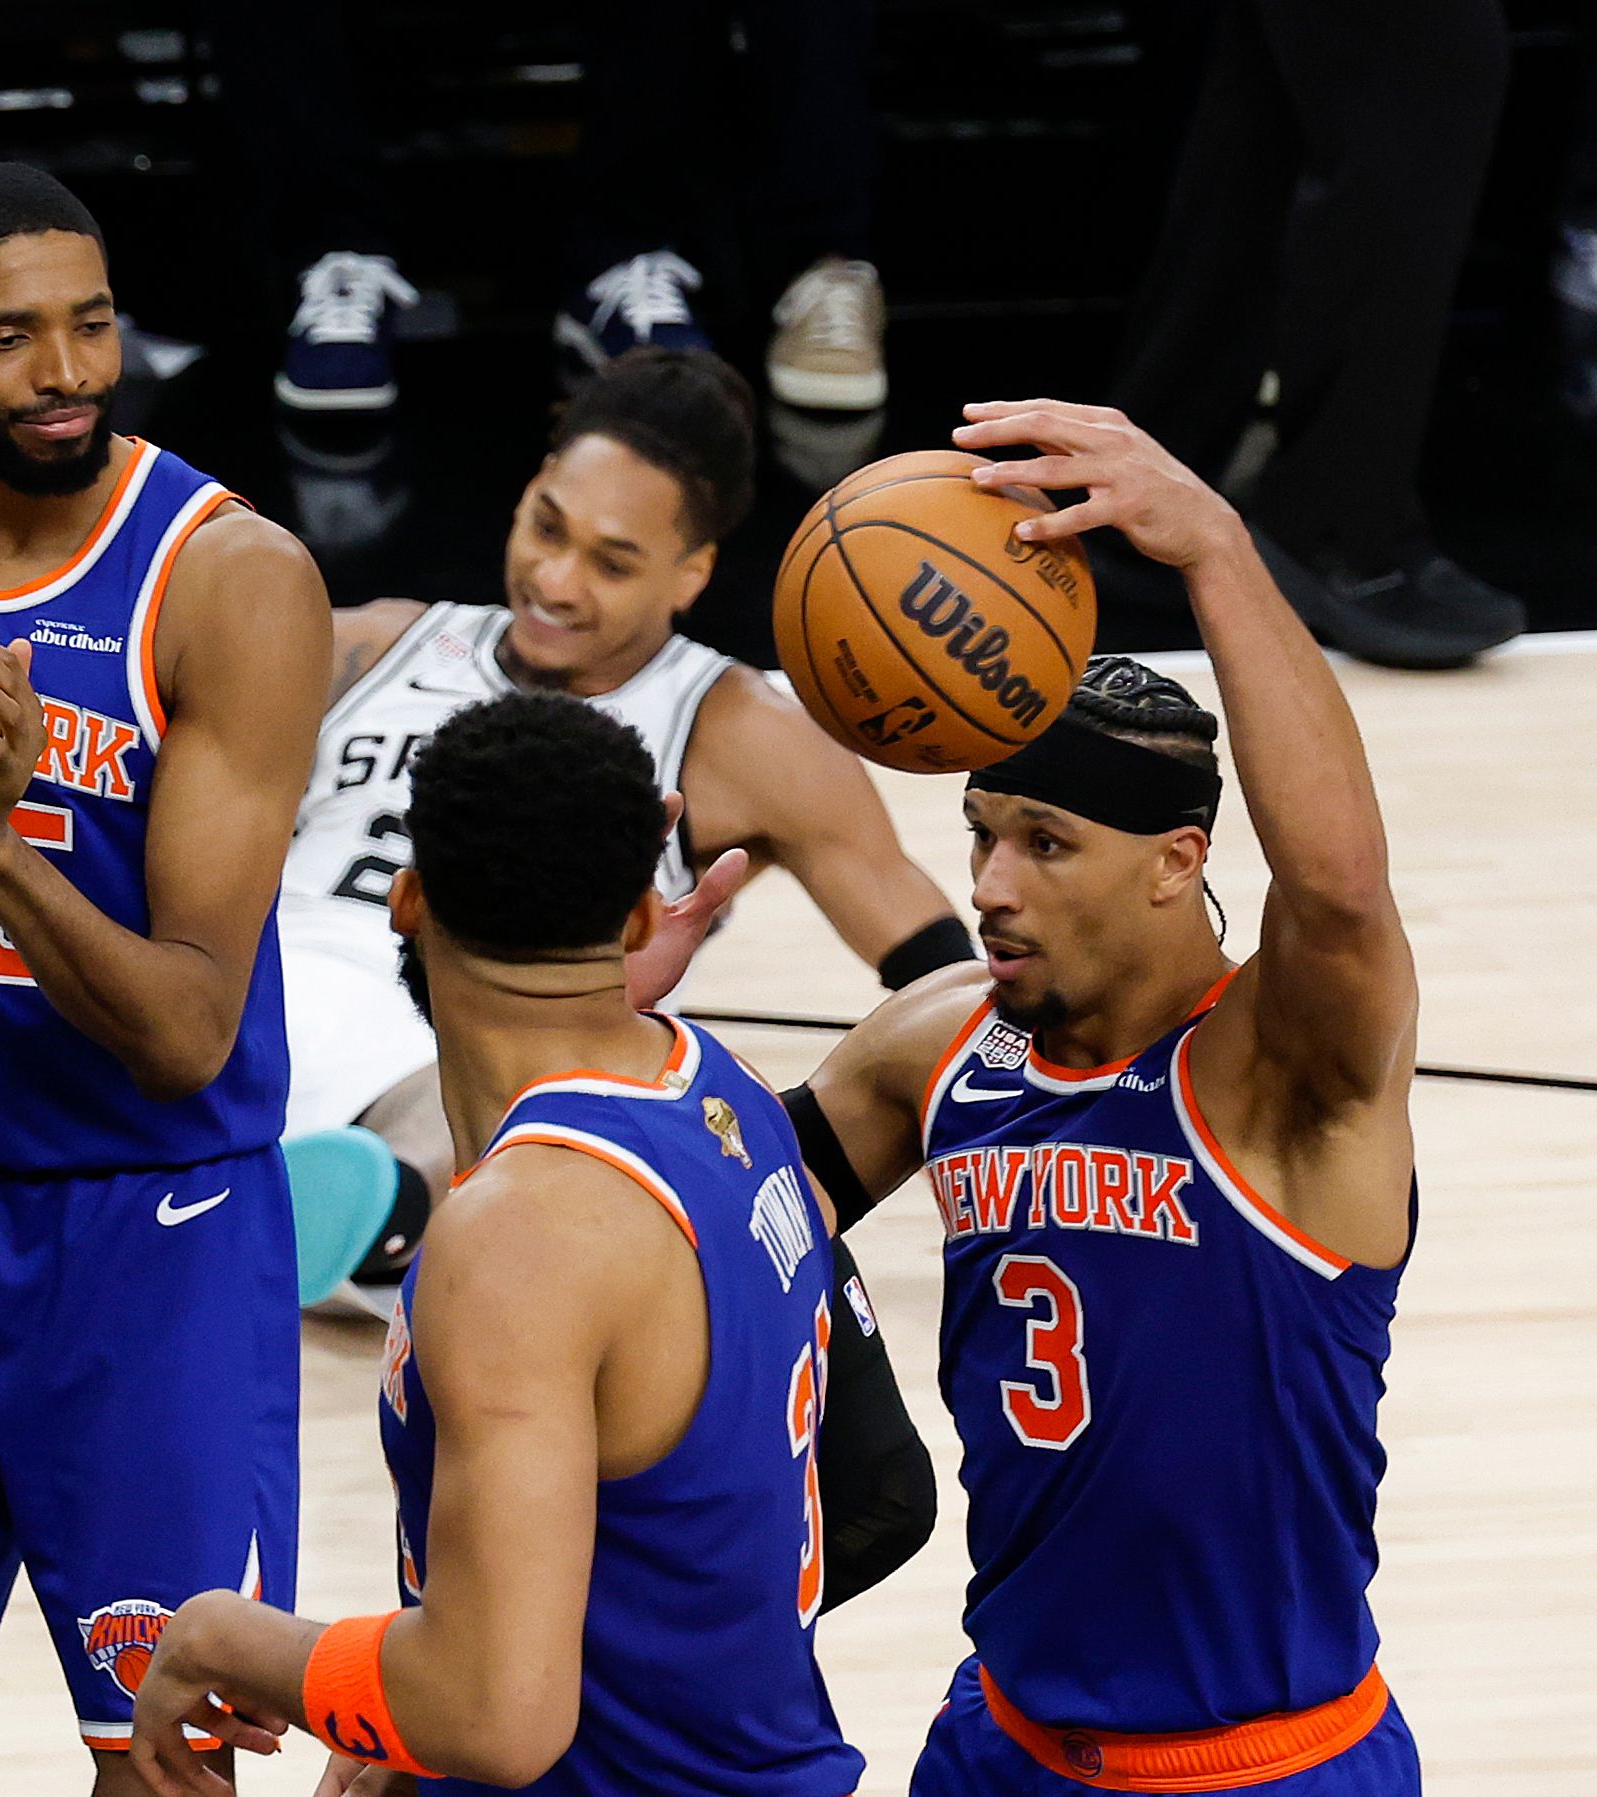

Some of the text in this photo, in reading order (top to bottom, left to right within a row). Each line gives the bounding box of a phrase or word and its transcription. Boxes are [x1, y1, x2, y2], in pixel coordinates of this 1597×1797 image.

[30, 628, 124, 653] abu dhabi
[900, 559, 1048, 729] Wilson
[32, 697, 141, 802] RK
[977, 1040, 1019, 1065] 250
[993, 1026, 1027, 1050] USA
[925, 1142, 1199, 1247] NEW YORK
[992, 1254, 1091, 1451] 3
